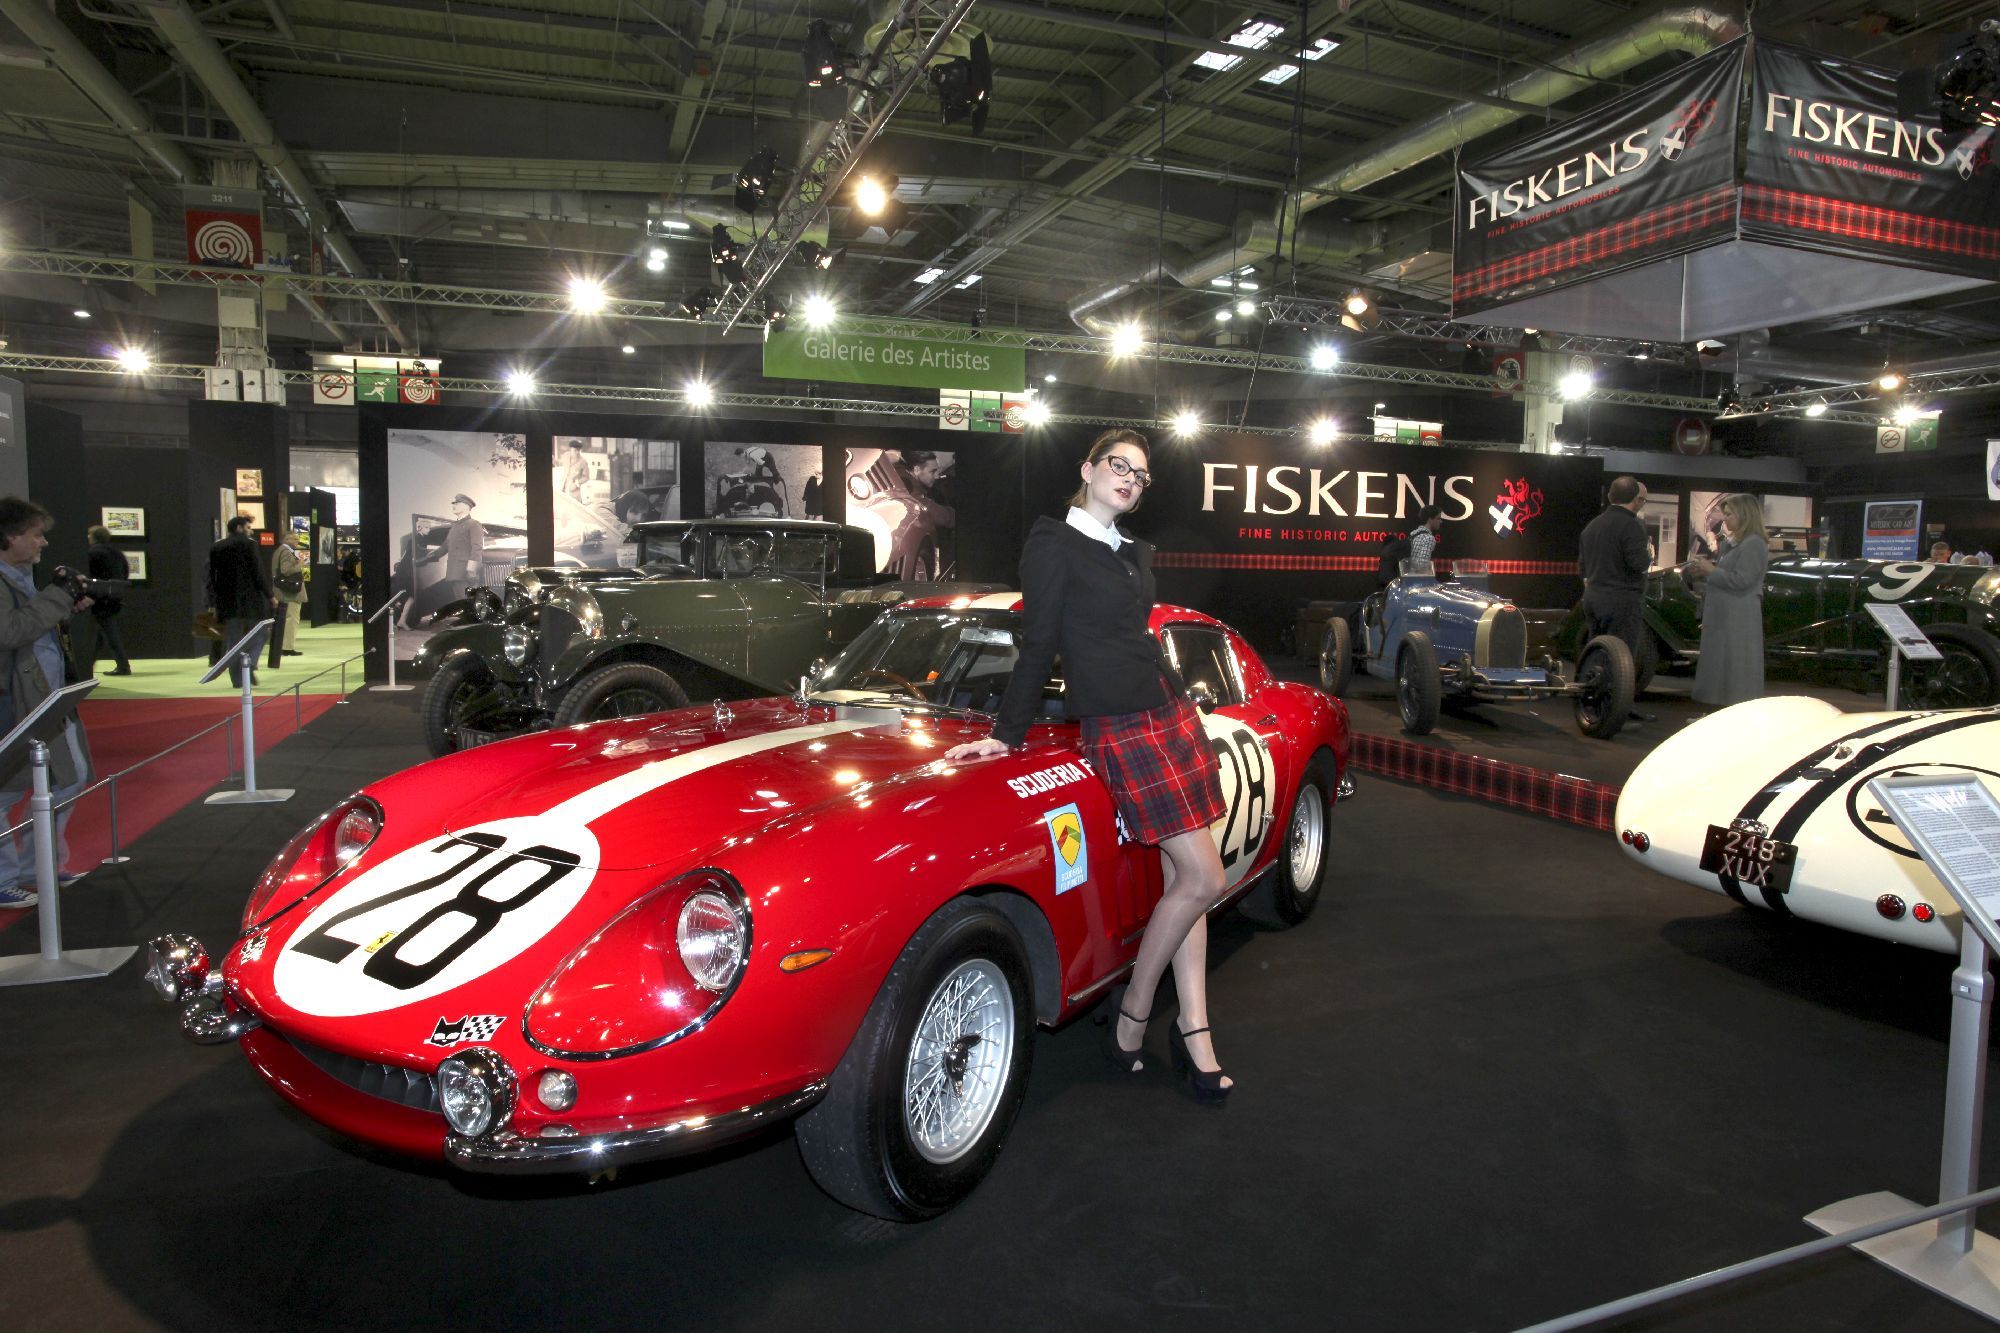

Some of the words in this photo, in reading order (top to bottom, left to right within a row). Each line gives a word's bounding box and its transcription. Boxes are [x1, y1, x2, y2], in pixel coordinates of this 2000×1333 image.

[1764, 92, 1946, 166] FISKENS
[1468, 128, 1649, 230] FISKENS
[1787, 147, 1809, 160] FINE
[1814, 153, 1858, 170] HISTORIC
[1862, 163, 1922, 182] AUTOMOBILES
[1487, 226, 1505, 239] FINE
[1510, 211, 1551, 230] HISTORIC
[1556, 185, 1621, 215] AUTOMOBILES
[803, 337, 875, 363] Galerie
[882, 342, 914, 365] des
[920, 346, 991, 371] Artistes
[1201, 462, 1474, 521] FISKENS
[1239, 527, 1272, 539] FINE
[1281, 529, 1348, 541] HISTORIC
[1867, 562, 1936, 601] 9
[1007, 762, 1087, 799] SCUDERIA
[1211, 728, 1266, 870] 28
[1724, 831, 1776, 862] 248
[1719, 853, 1771, 887] XUX
[289, 831, 582, 990] 28
